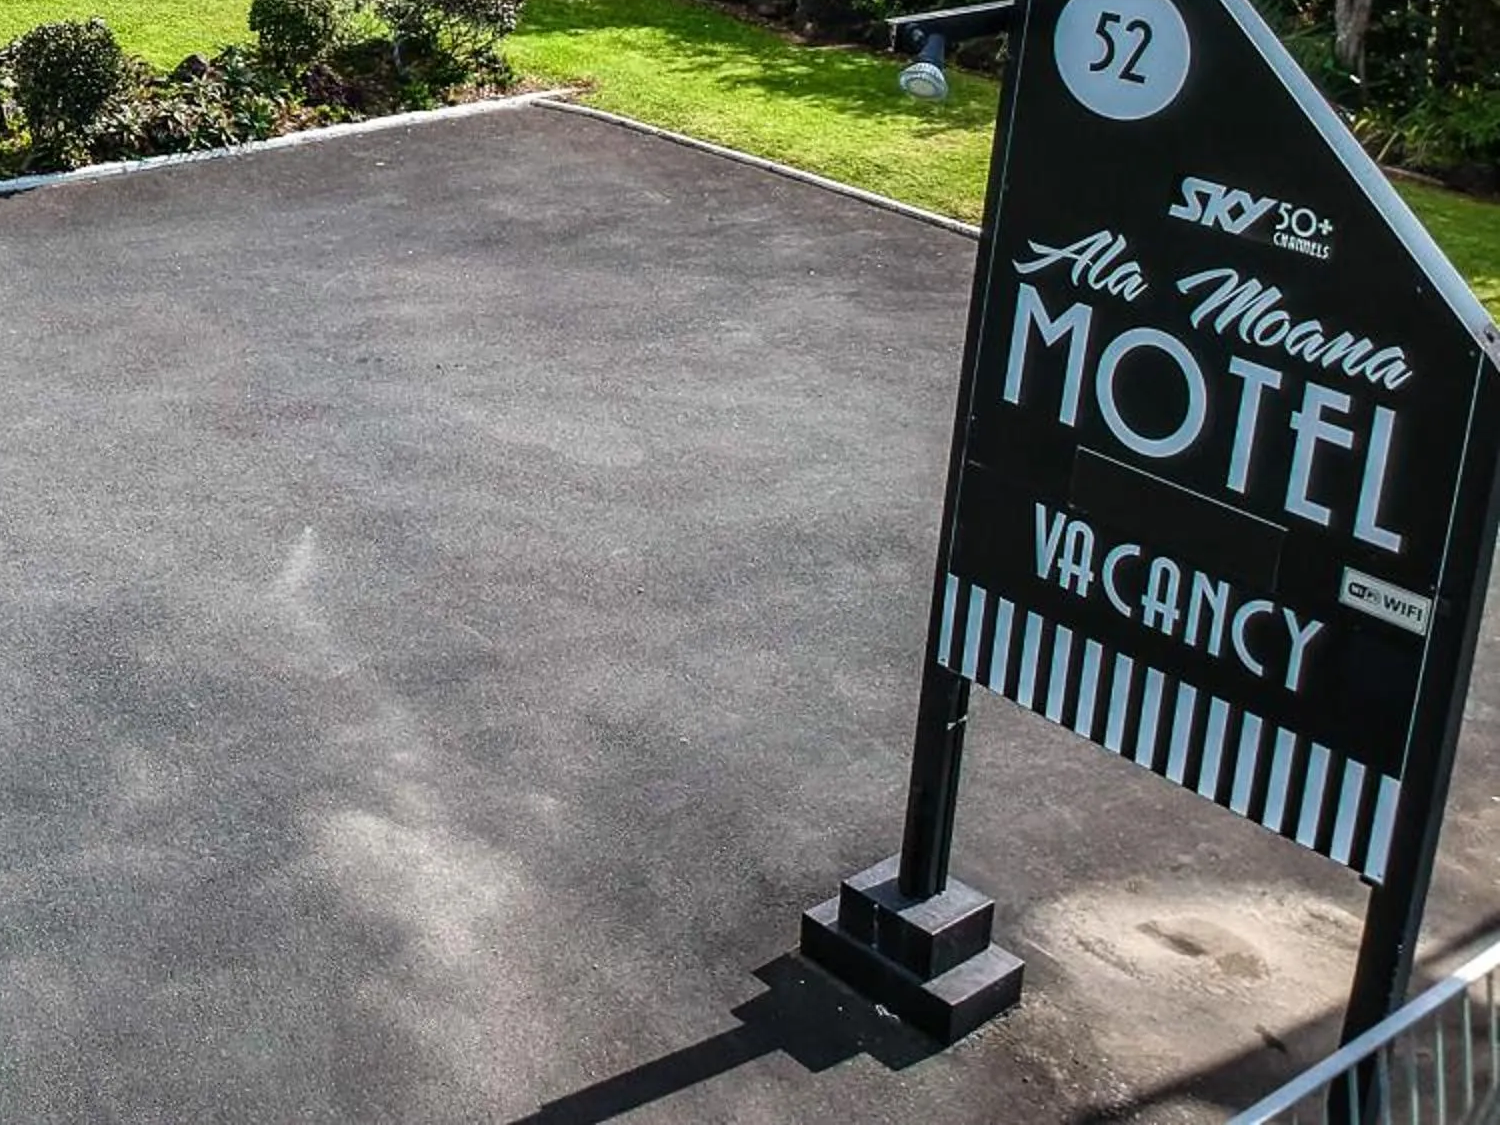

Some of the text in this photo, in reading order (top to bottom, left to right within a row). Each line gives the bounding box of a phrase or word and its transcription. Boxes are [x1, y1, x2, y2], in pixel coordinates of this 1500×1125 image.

[1089, 12, 1152, 83] 52
[1168, 177, 1333, 237] SKY 50+
[1273, 231, 1330, 259] CHANNELS
[1012, 230, 1412, 390] Ala Moana
[1003, 282, 1402, 553] MOTEL
[1034, 502, 1324, 692] VACANCY
[1383, 595, 1422, 622] WIFI
